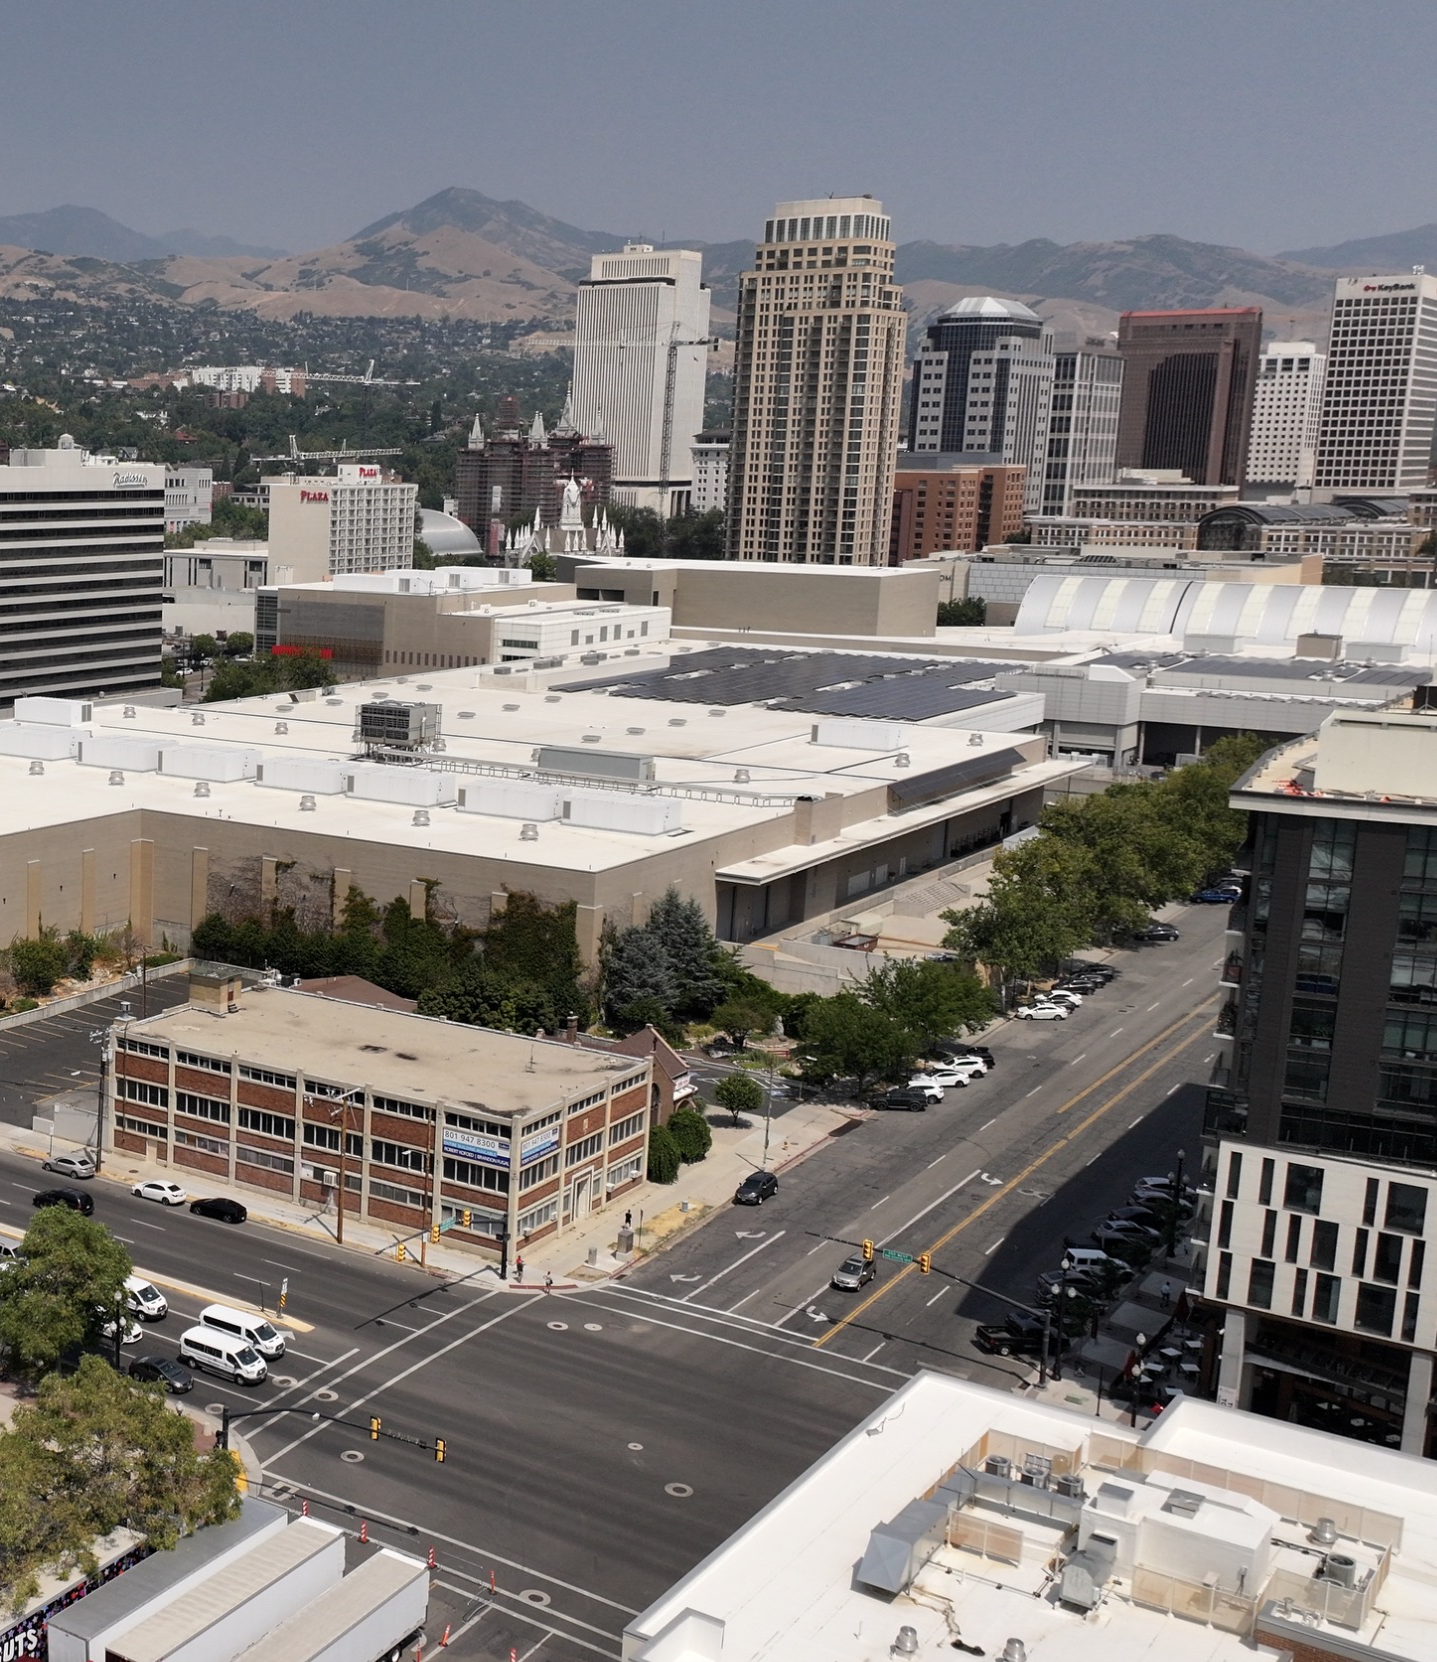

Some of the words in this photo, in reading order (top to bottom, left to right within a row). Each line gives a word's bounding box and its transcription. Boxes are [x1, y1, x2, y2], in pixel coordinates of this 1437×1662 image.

[1378, 283, 1416, 293] KeyBank
[300, 490, 329, 503] PLAZA
[445, 1130, 458, 1139] 801
[460, 1134, 475, 1143] 947
[476, 1138, 496, 1149] 8300
